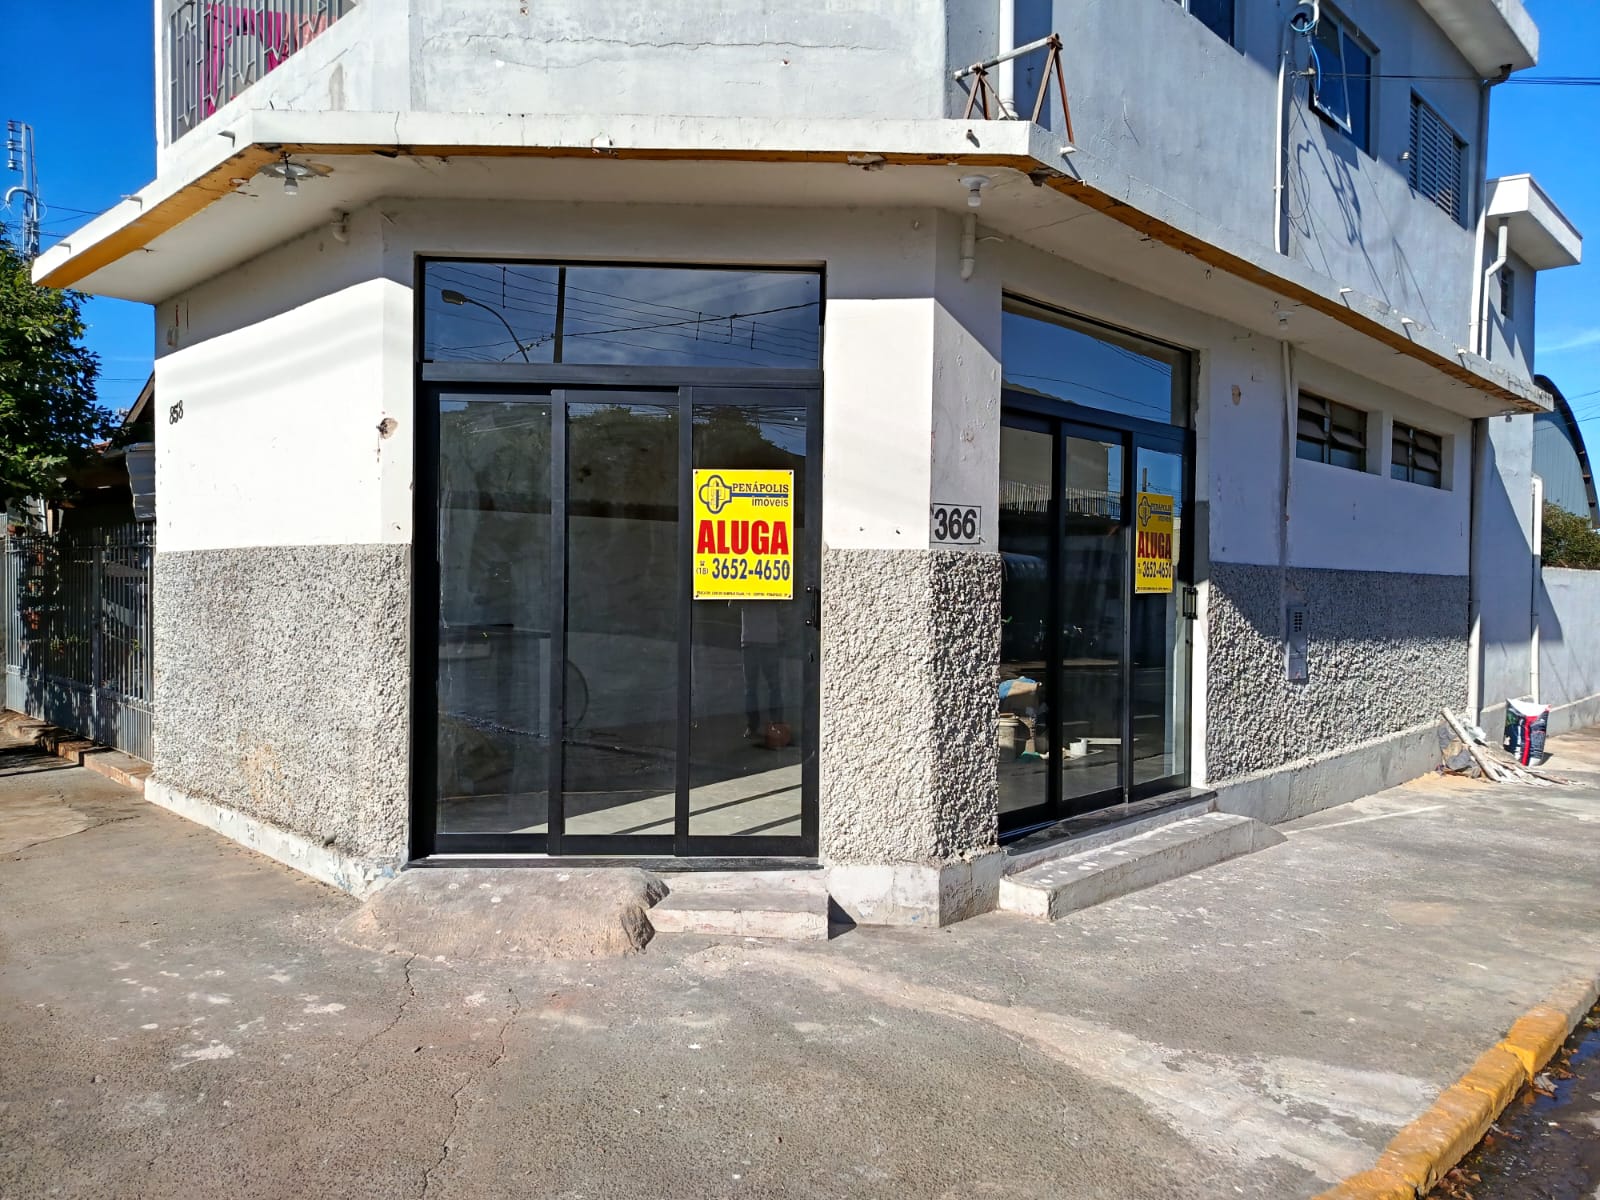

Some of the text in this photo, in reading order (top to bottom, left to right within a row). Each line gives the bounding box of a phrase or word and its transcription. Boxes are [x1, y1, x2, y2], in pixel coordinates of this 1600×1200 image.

[169, 399, 184, 425] 858
[732, 482, 789, 493] PENÁPOLIS
[751, 495, 789, 507] imóveis
[934, 507, 978, 541] 366
[696, 520, 790, 555] ALUGA
[1137, 531, 1172, 560] ALUGA
[712, 558, 791, 581] 3652-4650
